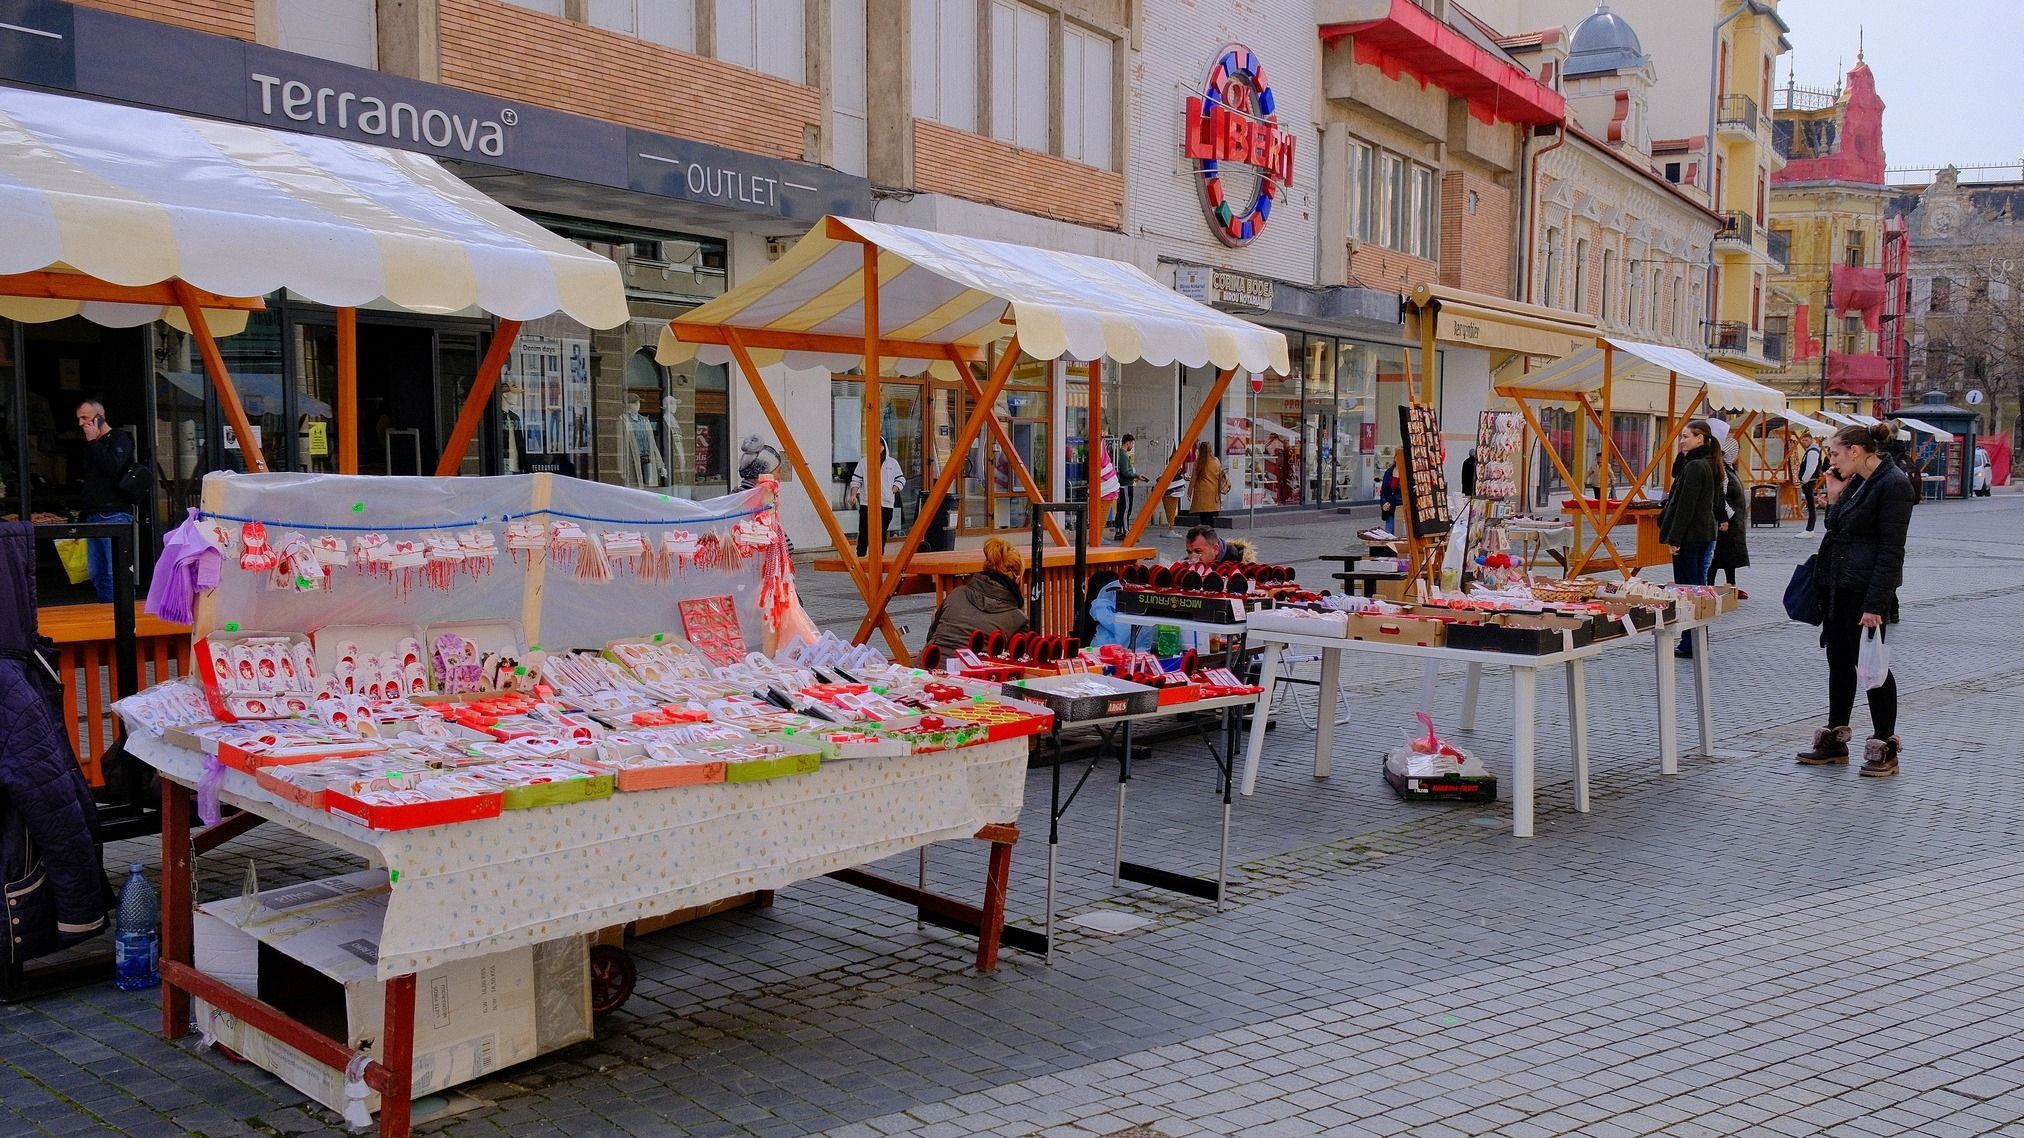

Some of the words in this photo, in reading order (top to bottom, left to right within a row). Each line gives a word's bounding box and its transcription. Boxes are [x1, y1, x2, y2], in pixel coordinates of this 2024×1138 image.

[251, 73, 504, 157] Terranova
[687, 163, 777, 207] OUTLET
[1213, 272, 1246, 293] CORINA
[1246, 279, 1274, 297] BODEA
[523, 342, 541, 352] Denim
[542, 343, 556, 353] days
